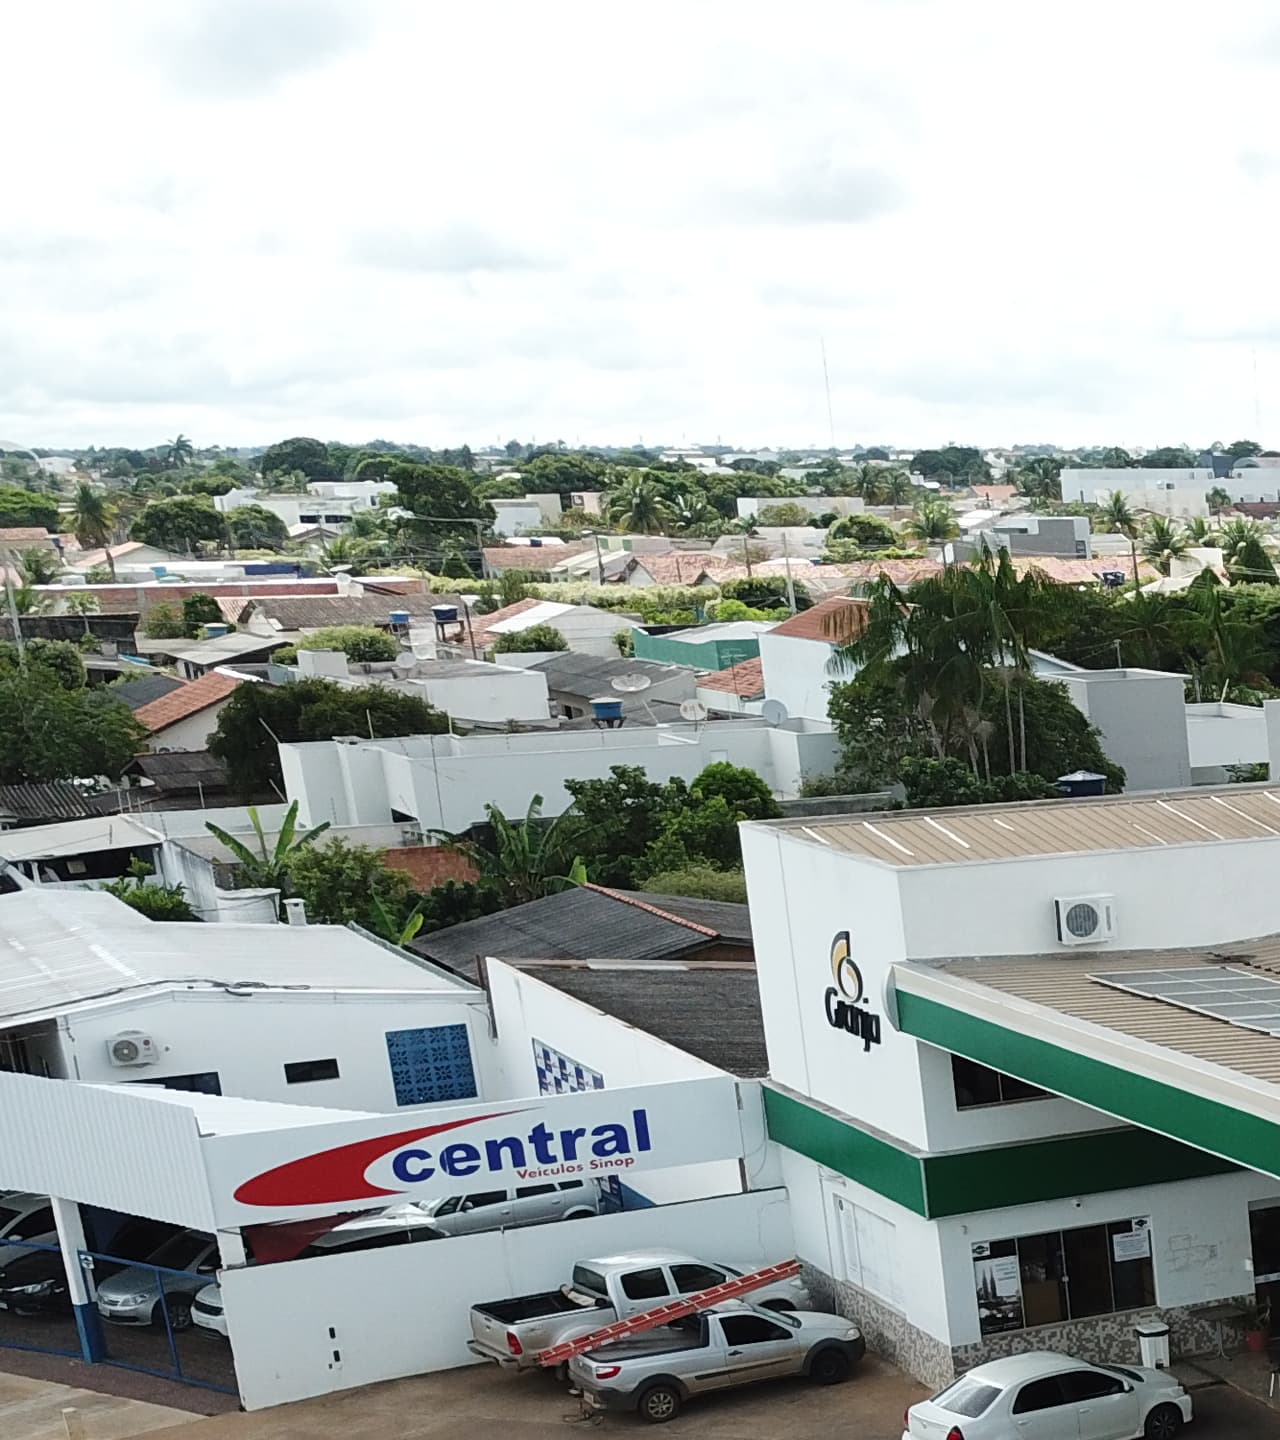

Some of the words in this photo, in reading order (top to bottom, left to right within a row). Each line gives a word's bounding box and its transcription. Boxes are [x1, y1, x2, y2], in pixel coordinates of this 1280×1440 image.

[825, 986, 881, 1053] Granja
[392, 1109, 652, 1183] central
[589, 1156, 635, 1170] Sinop
